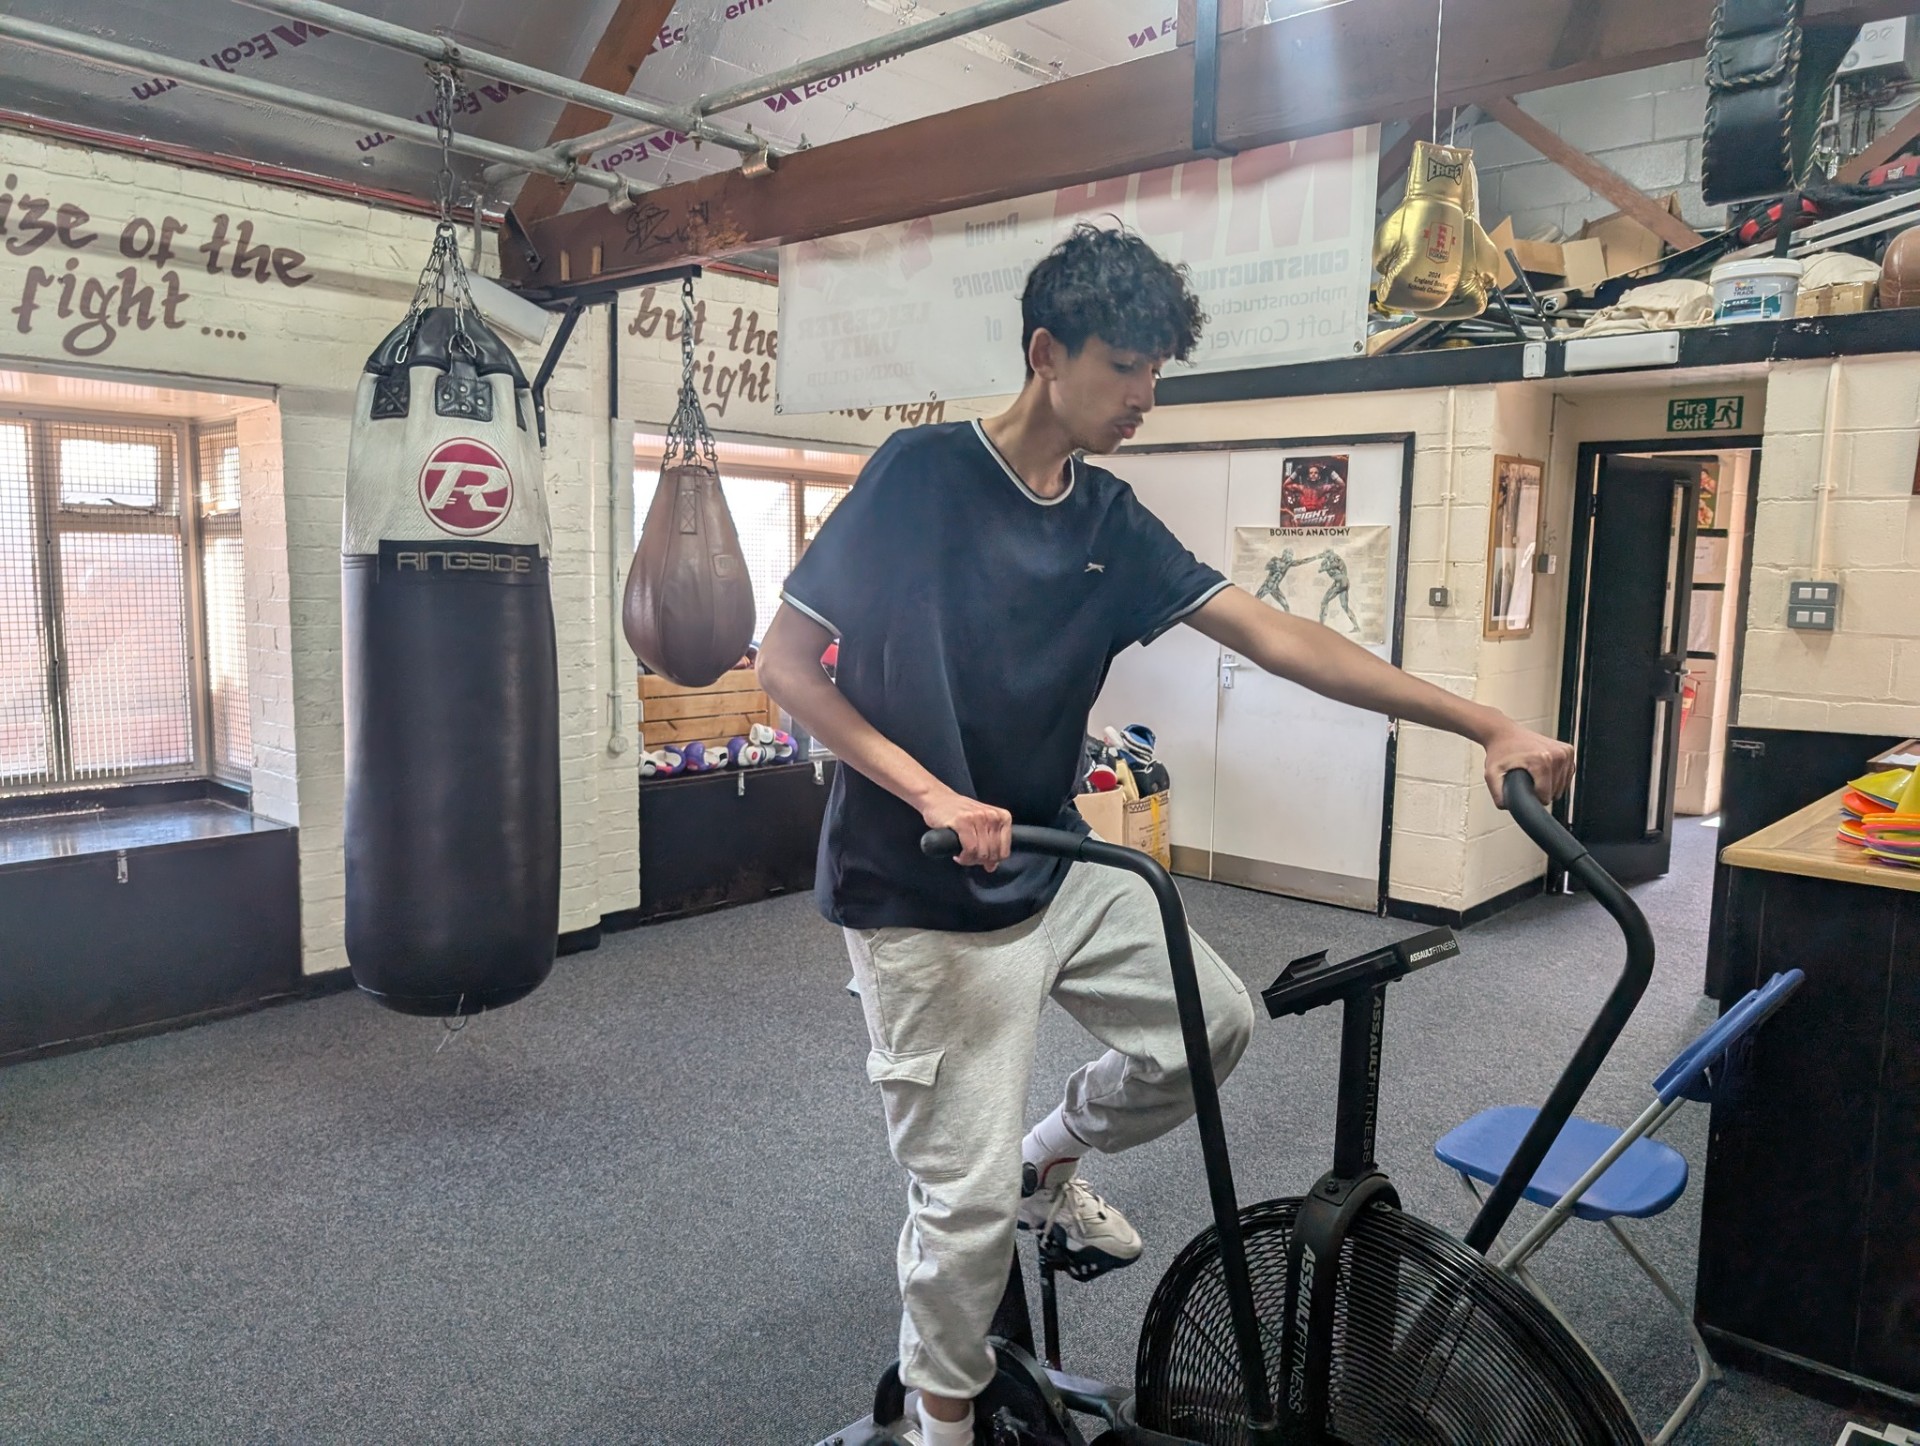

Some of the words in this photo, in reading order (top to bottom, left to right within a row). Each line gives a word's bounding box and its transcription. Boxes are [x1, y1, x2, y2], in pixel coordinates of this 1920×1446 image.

[119, 215, 188, 269] of
[200, 213, 314, 287] the
[11, 257, 189, 357] fight
[628, 287, 706, 346] but
[1673, 401, 1707, 416] Fire
[1672, 415, 1707, 430] exit
[1294, 509, 1329, 520] FIGHT
[1269, 528, 1304, 537] BOXING
[1305, 528, 1350, 537] ANATOMY
[397, 551, 531, 573] RINGSIDE
